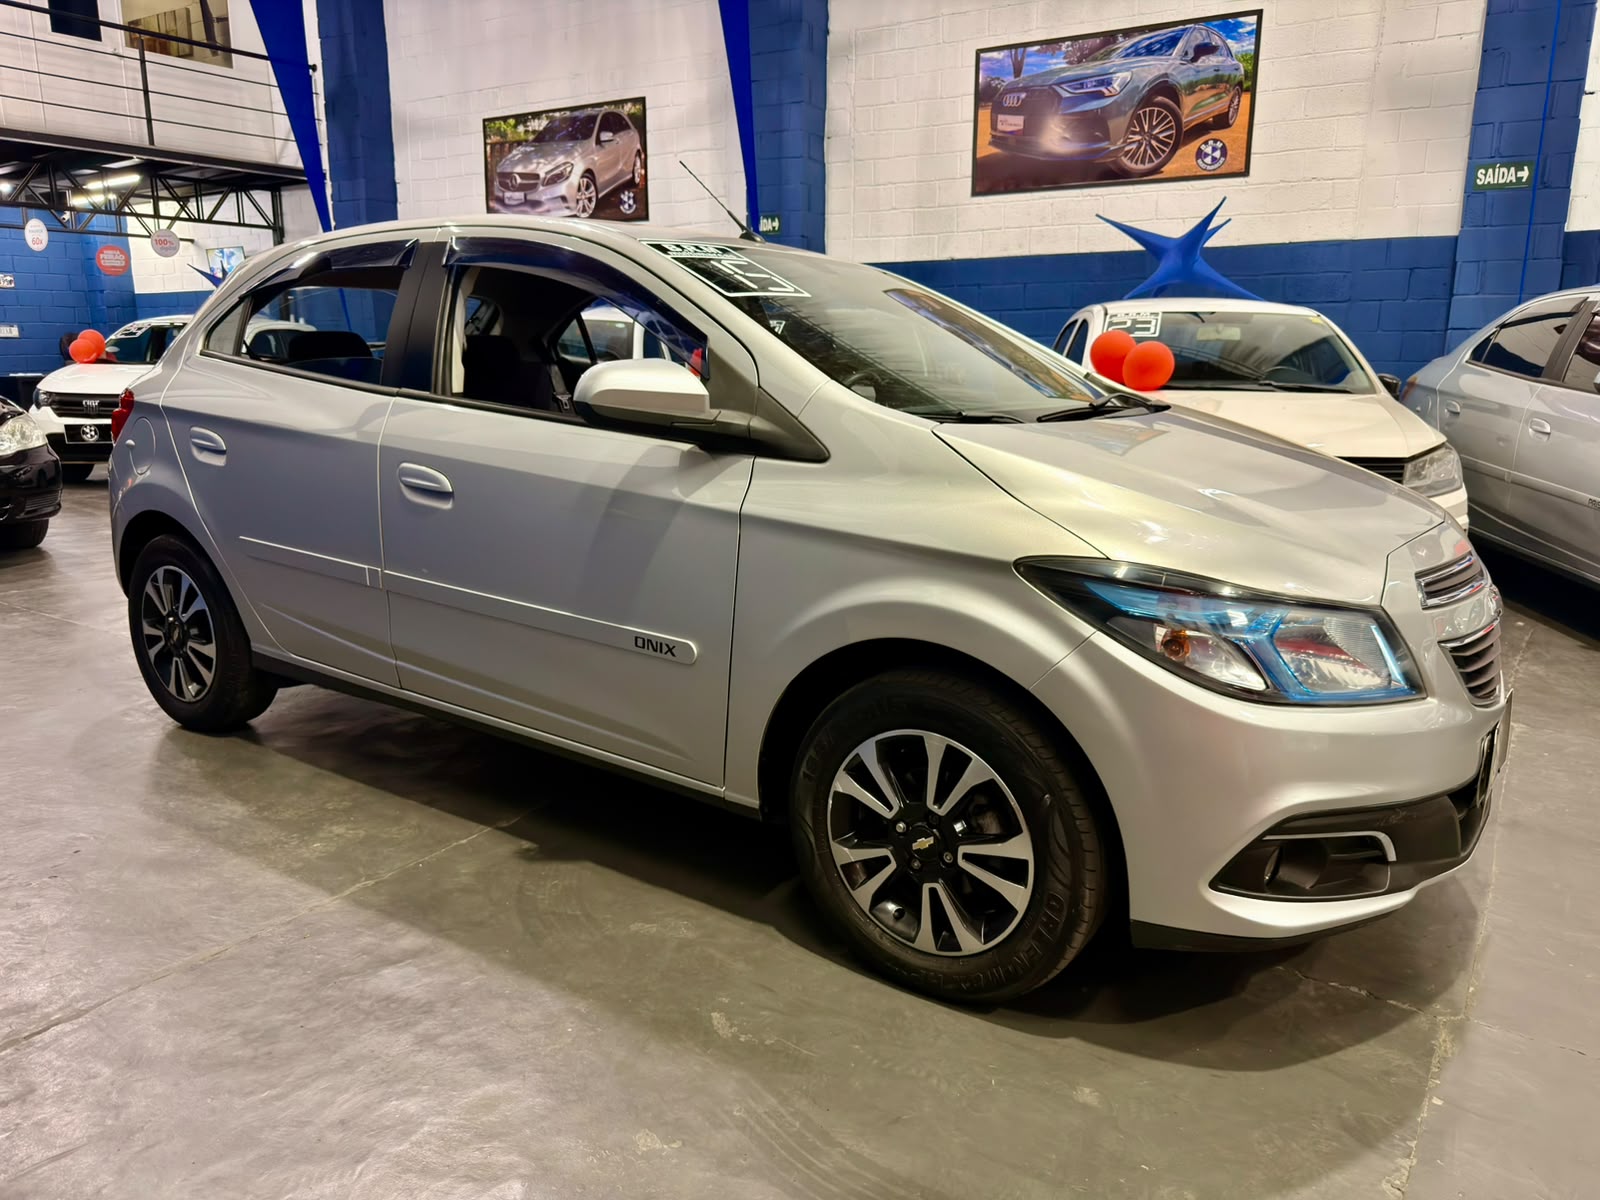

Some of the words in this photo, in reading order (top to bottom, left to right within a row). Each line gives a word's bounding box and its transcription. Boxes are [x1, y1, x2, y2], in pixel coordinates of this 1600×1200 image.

[1476, 163, 1516, 185] SAÍDA
[1108, 318, 1156, 335] 23
[634, 635, 677, 658] ONIX
